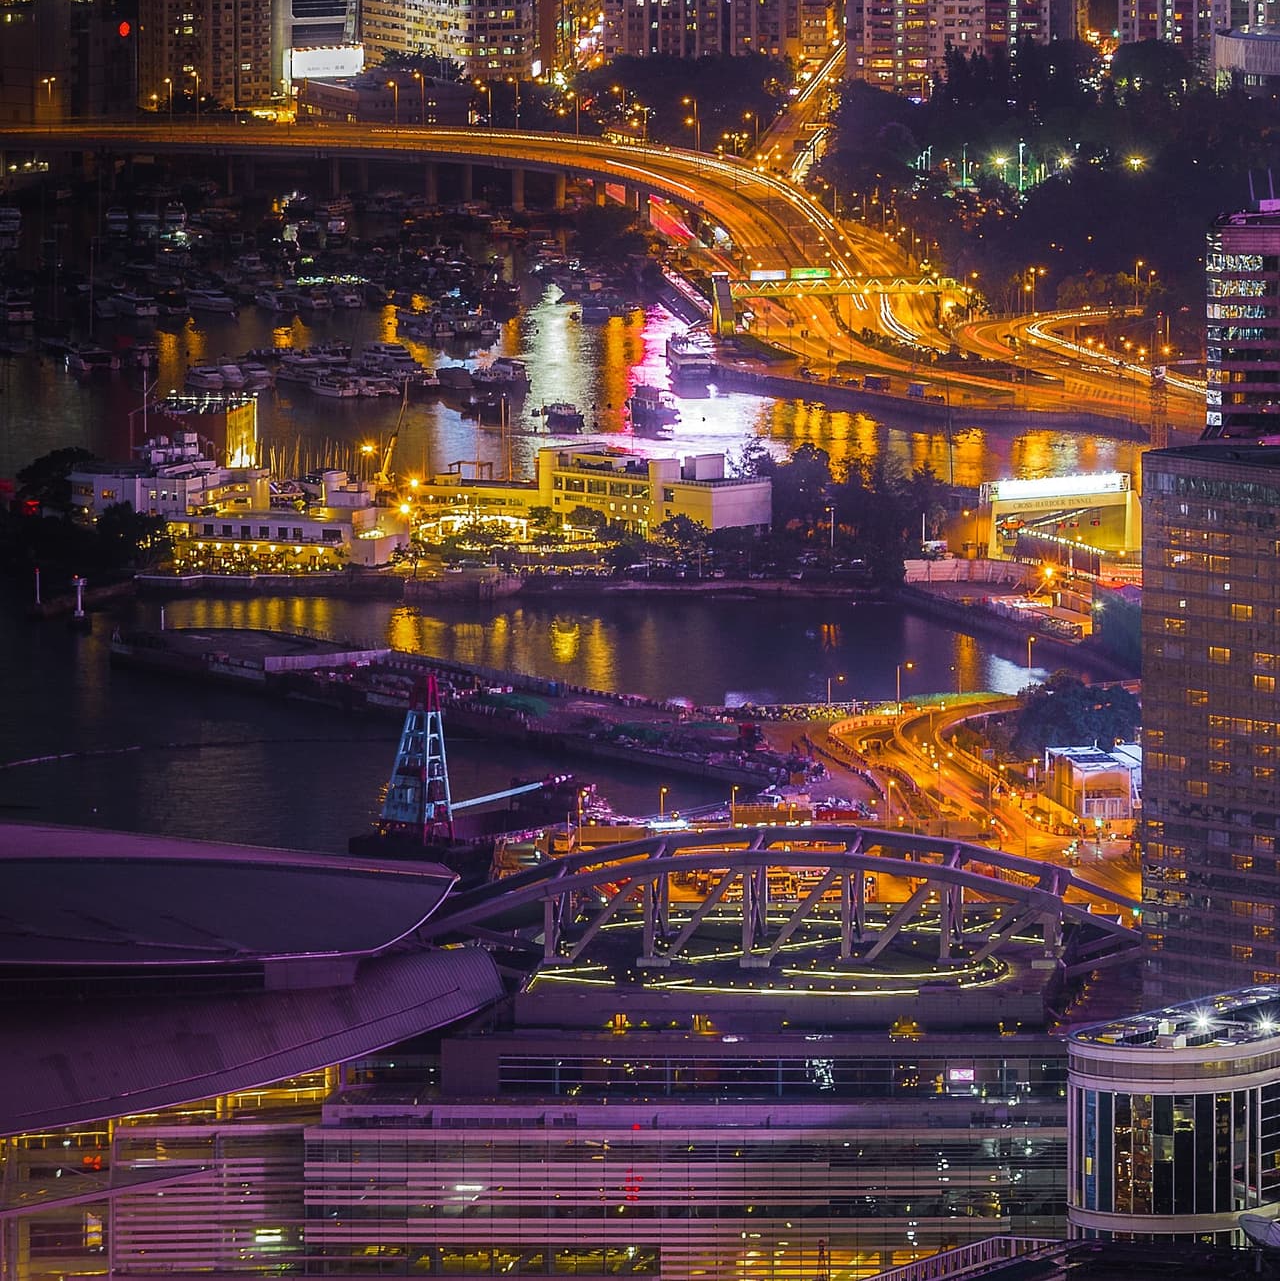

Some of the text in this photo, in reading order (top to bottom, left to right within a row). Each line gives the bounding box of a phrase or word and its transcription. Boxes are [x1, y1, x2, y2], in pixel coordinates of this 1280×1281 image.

[1013, 498, 1093, 510] CROSS HARBOUR TUNNEL
